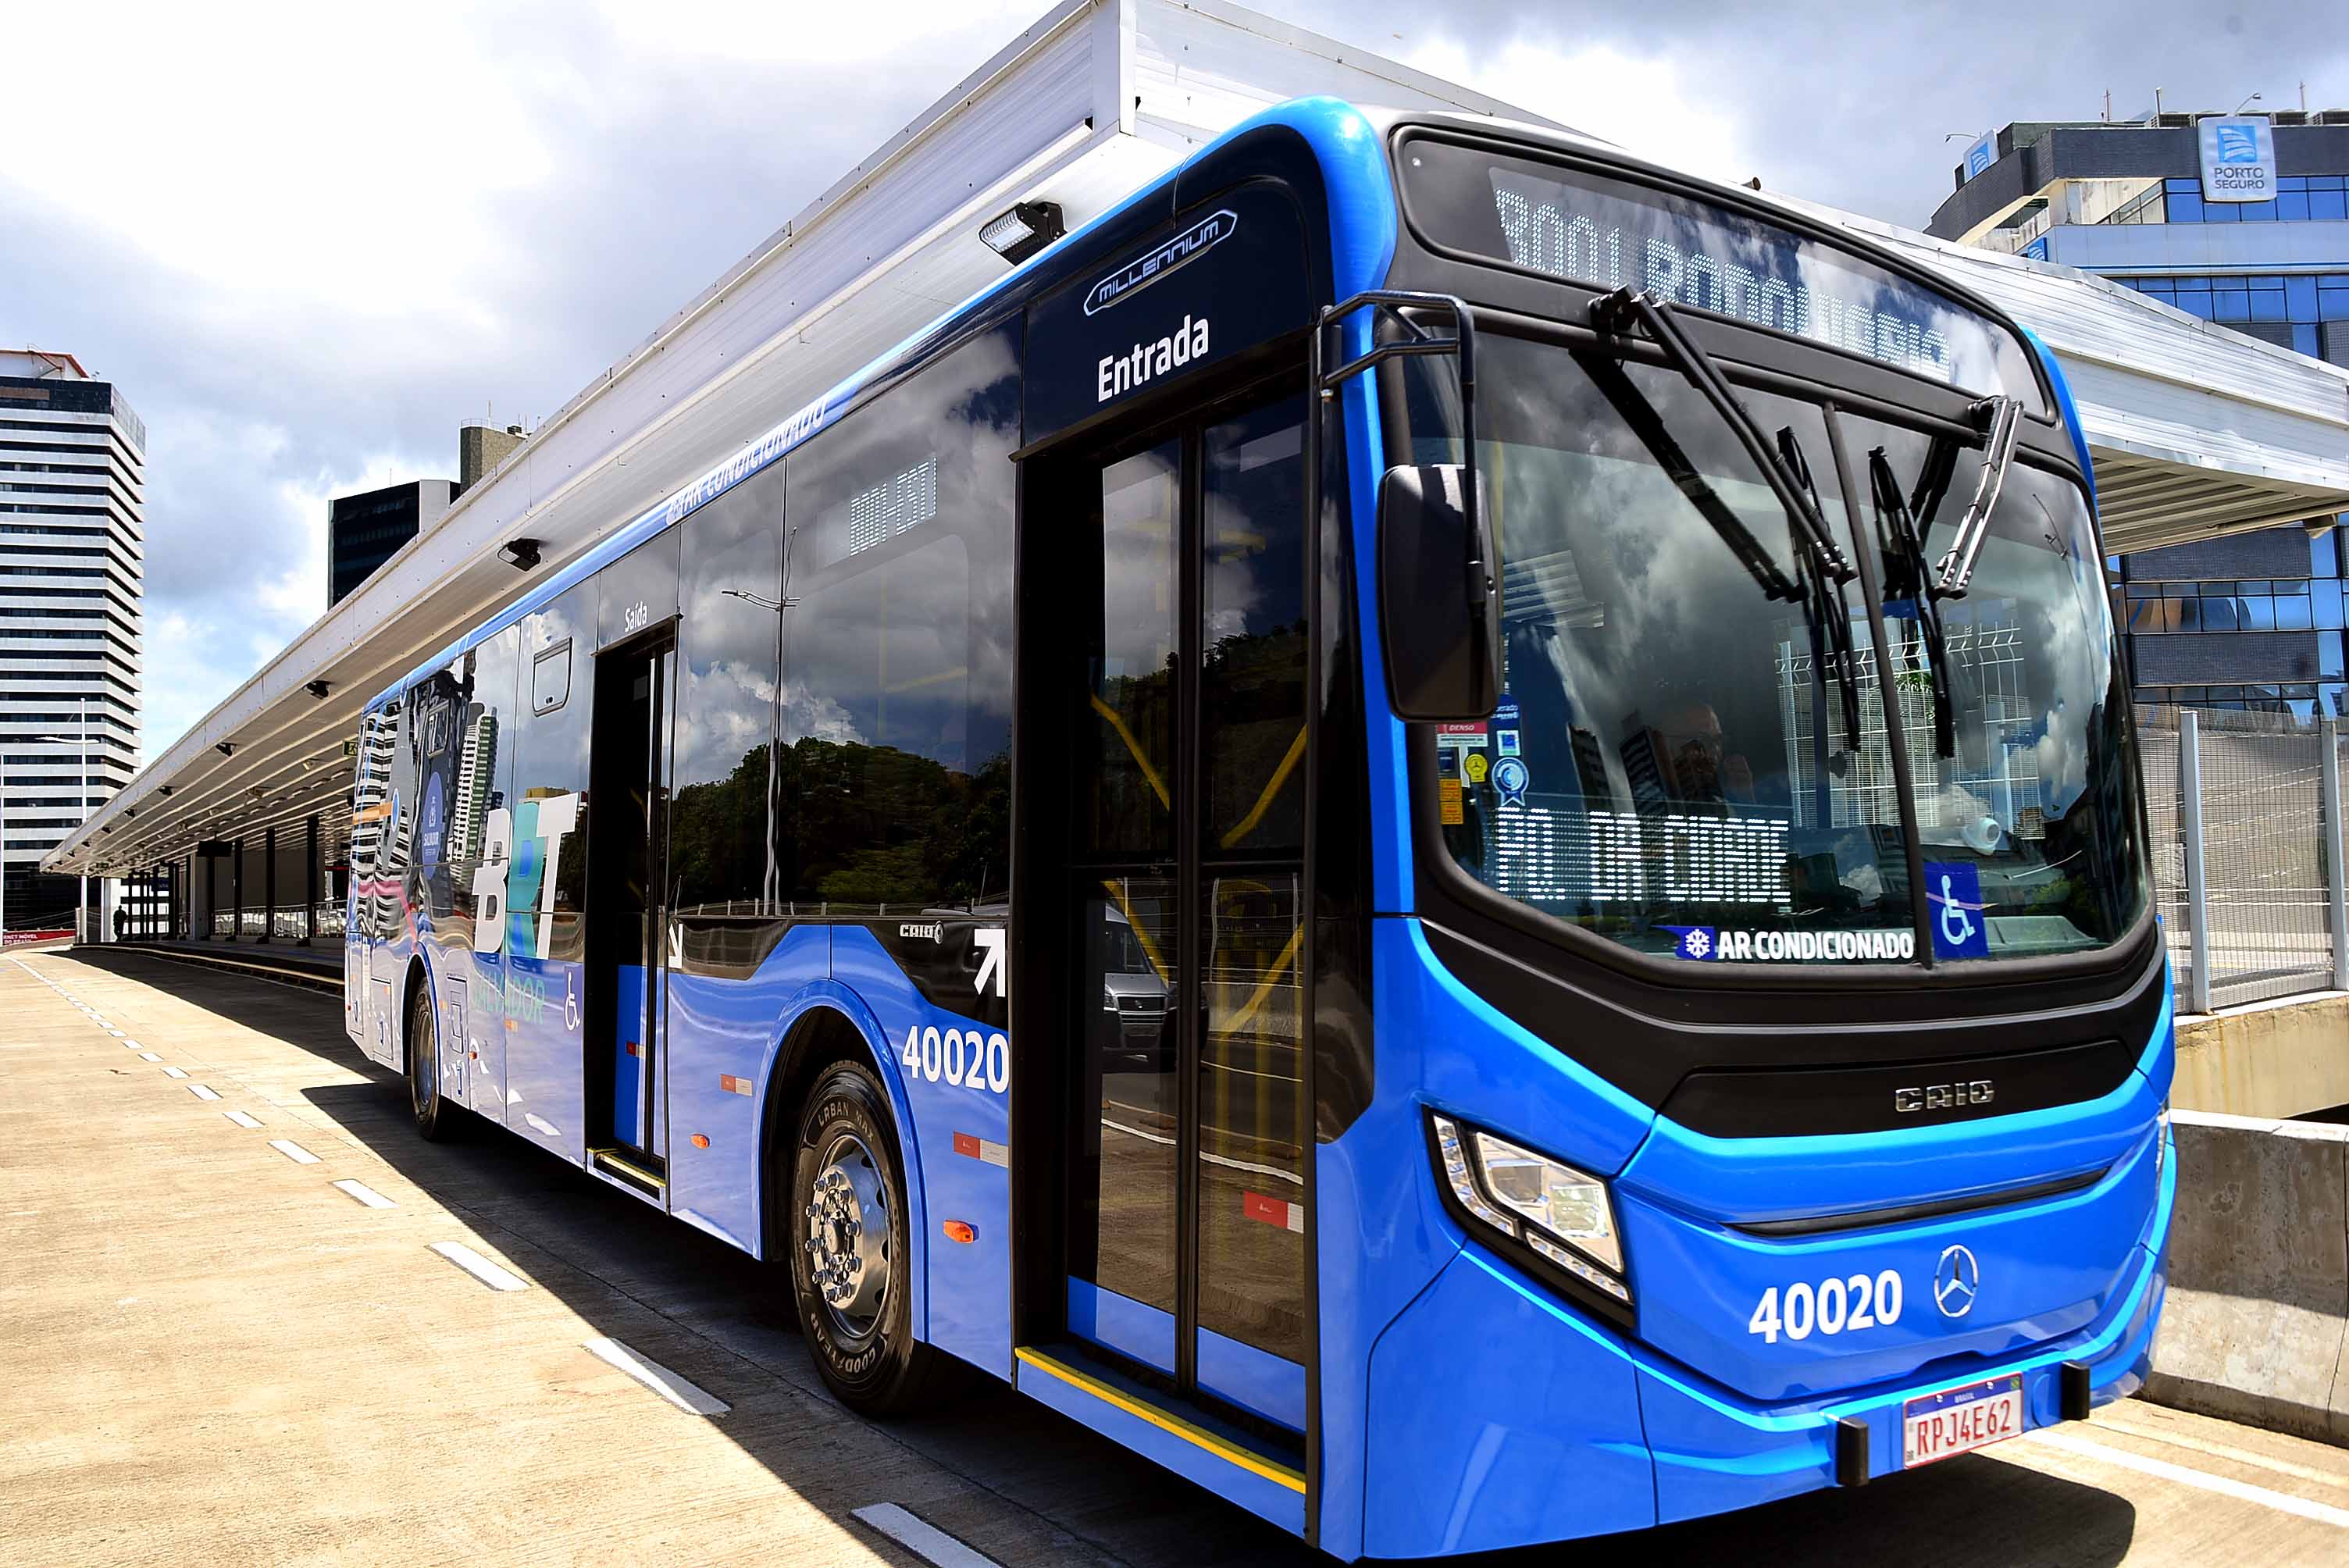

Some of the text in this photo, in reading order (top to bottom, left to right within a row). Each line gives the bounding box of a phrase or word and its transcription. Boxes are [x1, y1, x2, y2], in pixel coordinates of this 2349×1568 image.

[2214, 167, 2265, 179] PORTO
[2215, 180, 2265, 189] SEGURO
[1099, 220, 1219, 303] MILLENNIUM
[1098, 314, 1209, 403] Entrada
[625, 600, 647, 633] Saída
[472, 793, 579, 960] BRT
[1589, 811, 1642, 901] DA
[900, 924, 934, 938] CAIO
[1718, 931, 1915, 960] AR CONDICIONADO
[902, 1025, 1010, 1094] 40020
[818, 1101, 850, 1128] URBAN
[1895, 1080, 1995, 1113] CAIO
[1748, 1269, 1903, 1344] 40020
[1917, 1399, 2012, 1456] RPJ4E62
